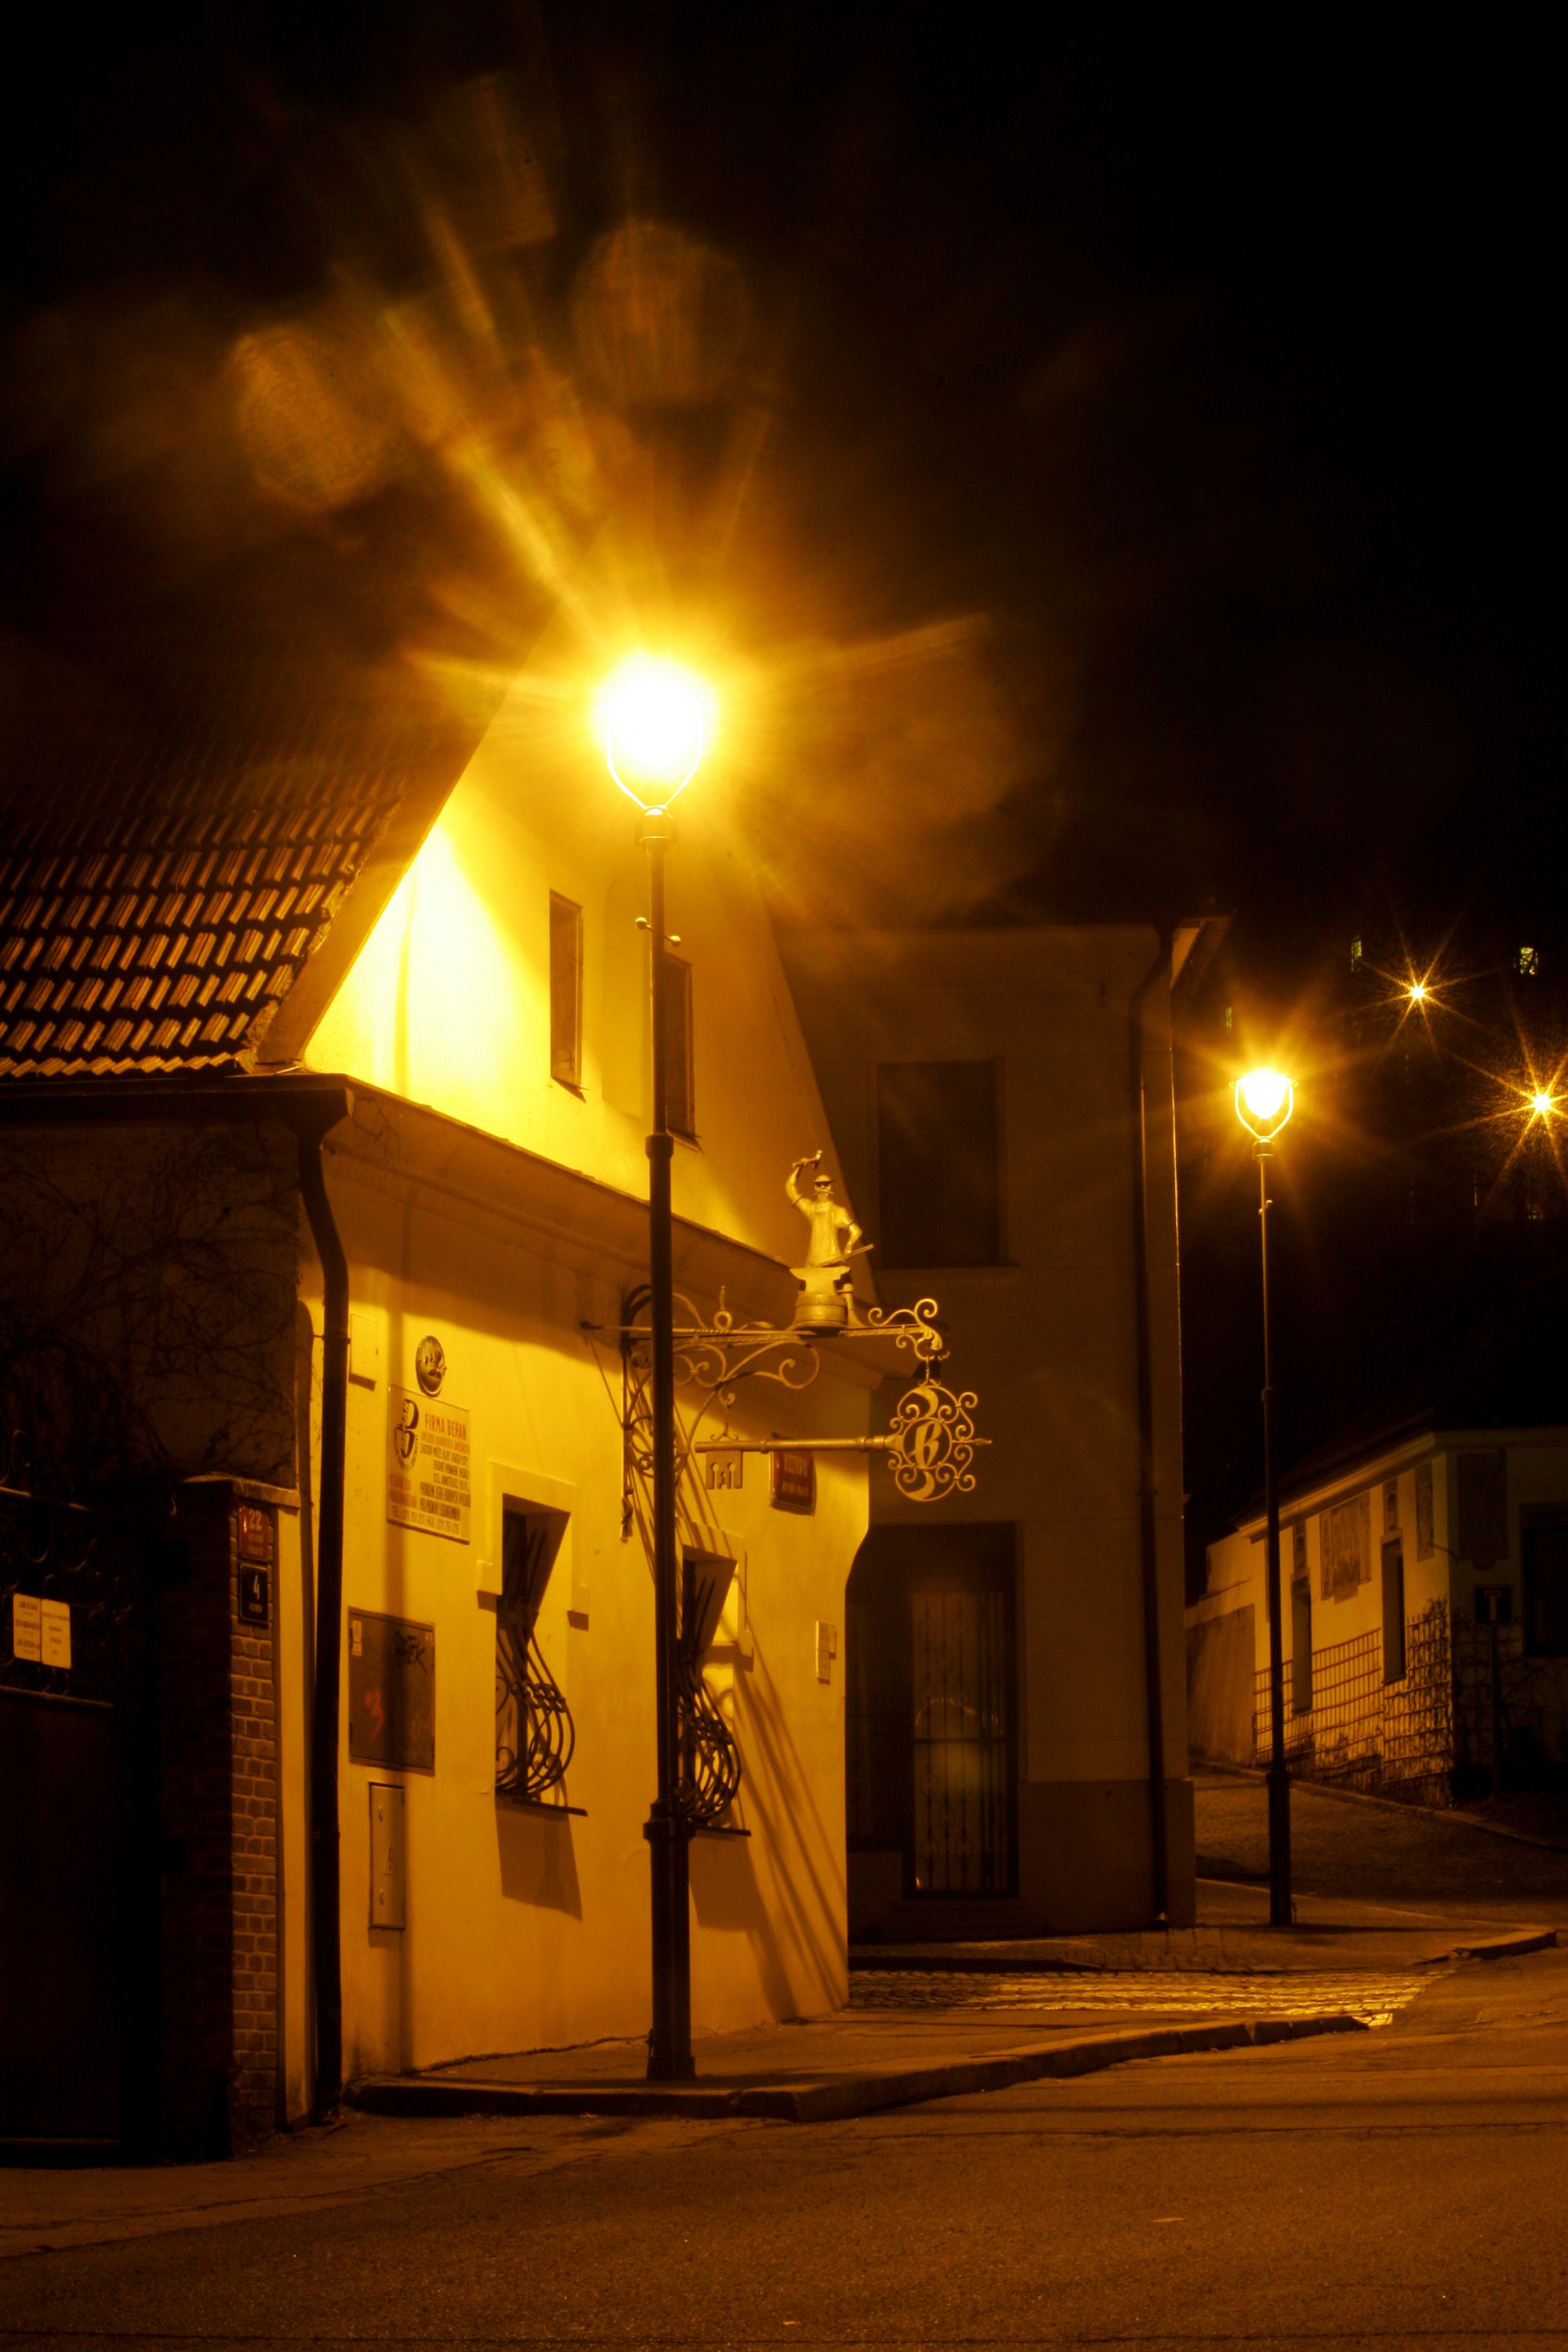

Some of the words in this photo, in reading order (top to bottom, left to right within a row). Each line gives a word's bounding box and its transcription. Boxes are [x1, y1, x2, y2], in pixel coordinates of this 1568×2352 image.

[425, 1413, 445, 1435] FIRMA
[447, 1417, 466, 1441] BERAN
[249, 1508, 263, 1531] 22
[253, 1574, 261, 1600] 4
